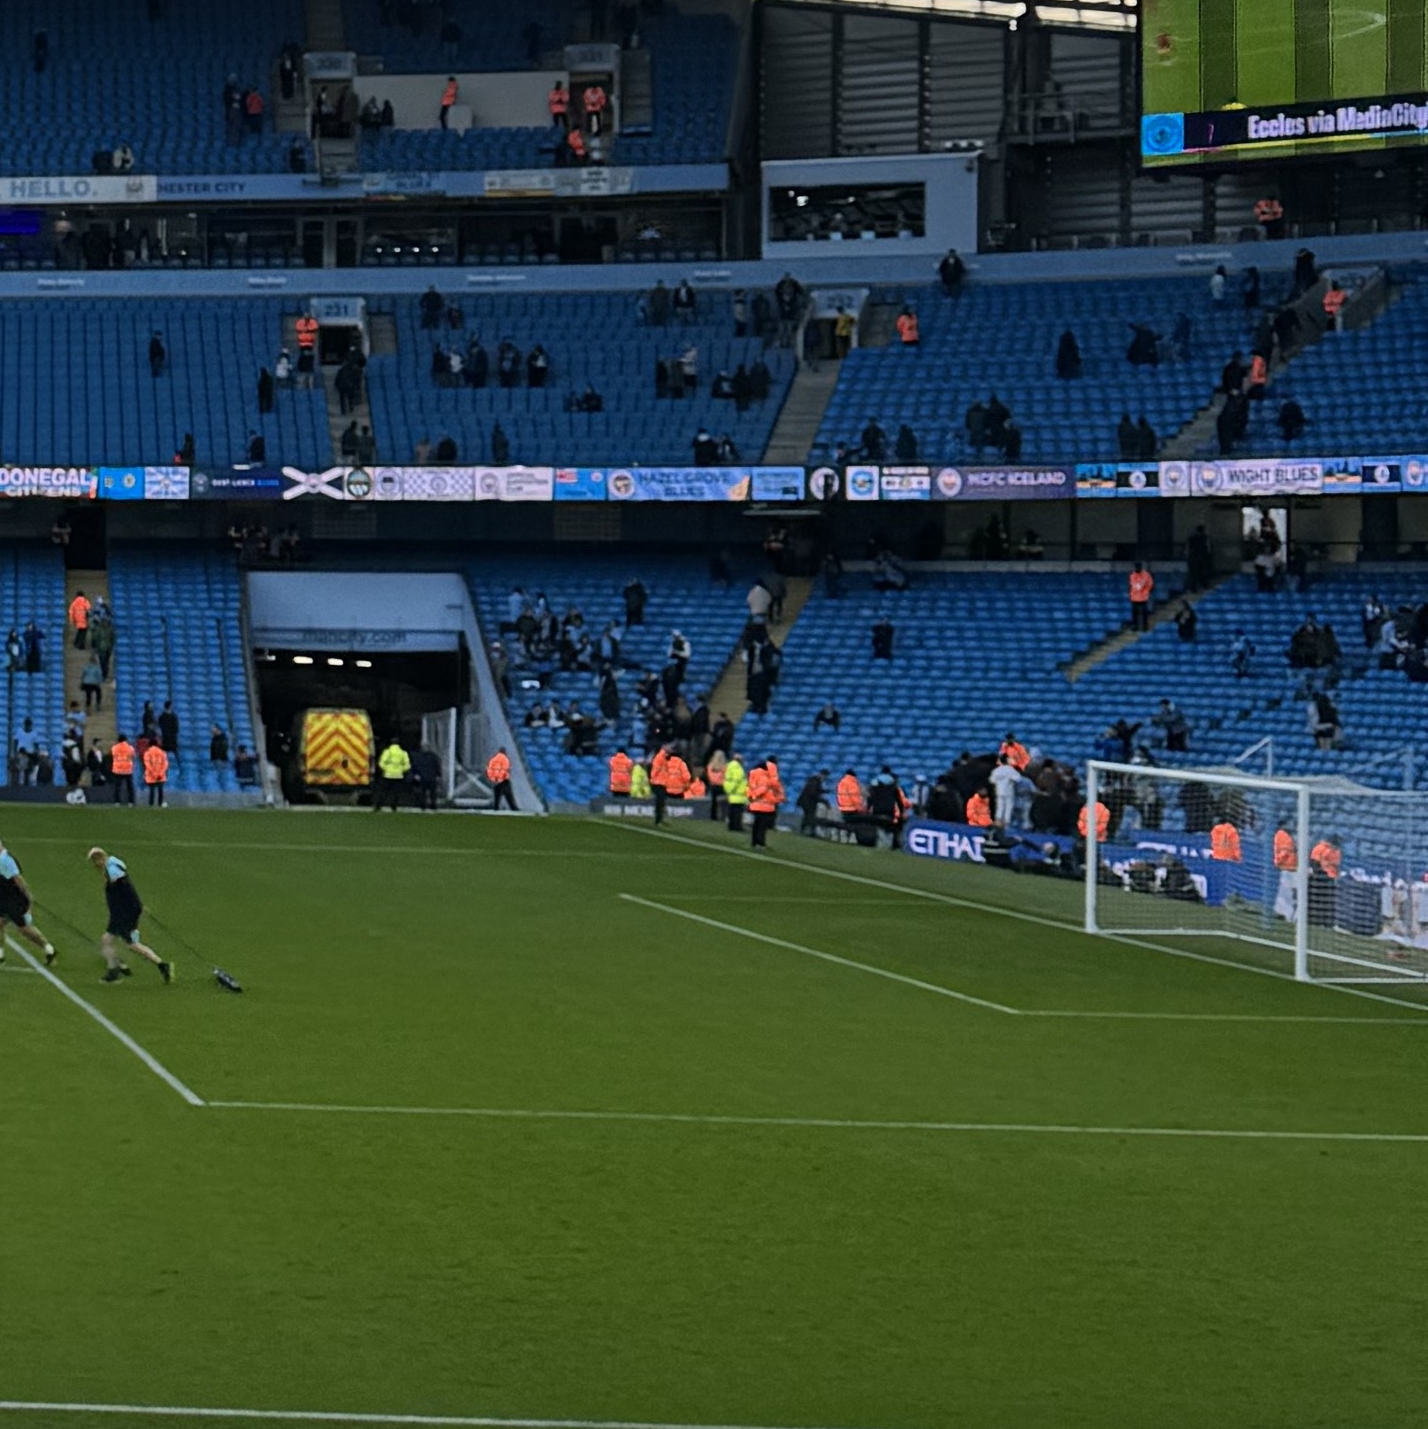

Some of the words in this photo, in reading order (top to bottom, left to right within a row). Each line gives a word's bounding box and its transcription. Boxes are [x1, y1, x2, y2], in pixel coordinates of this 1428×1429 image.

[1247, 114, 1305, 139] Eccles
[1308, 110, 1335, 134] via
[10, 179, 98, 199] HELLO.
[214, 181, 247, 193] CITY
[638, 471, 681, 484] HAZEL
[683, 472, 729, 484] GROVE
[968, 472, 1006, 485] MCFC
[1007, 473, 1066, 485] ICELAND
[1229, 470, 1270, 484] WIGHT
[1275, 467, 1318, 483] BLUES
[815, 825, 858, 844] NISSA
